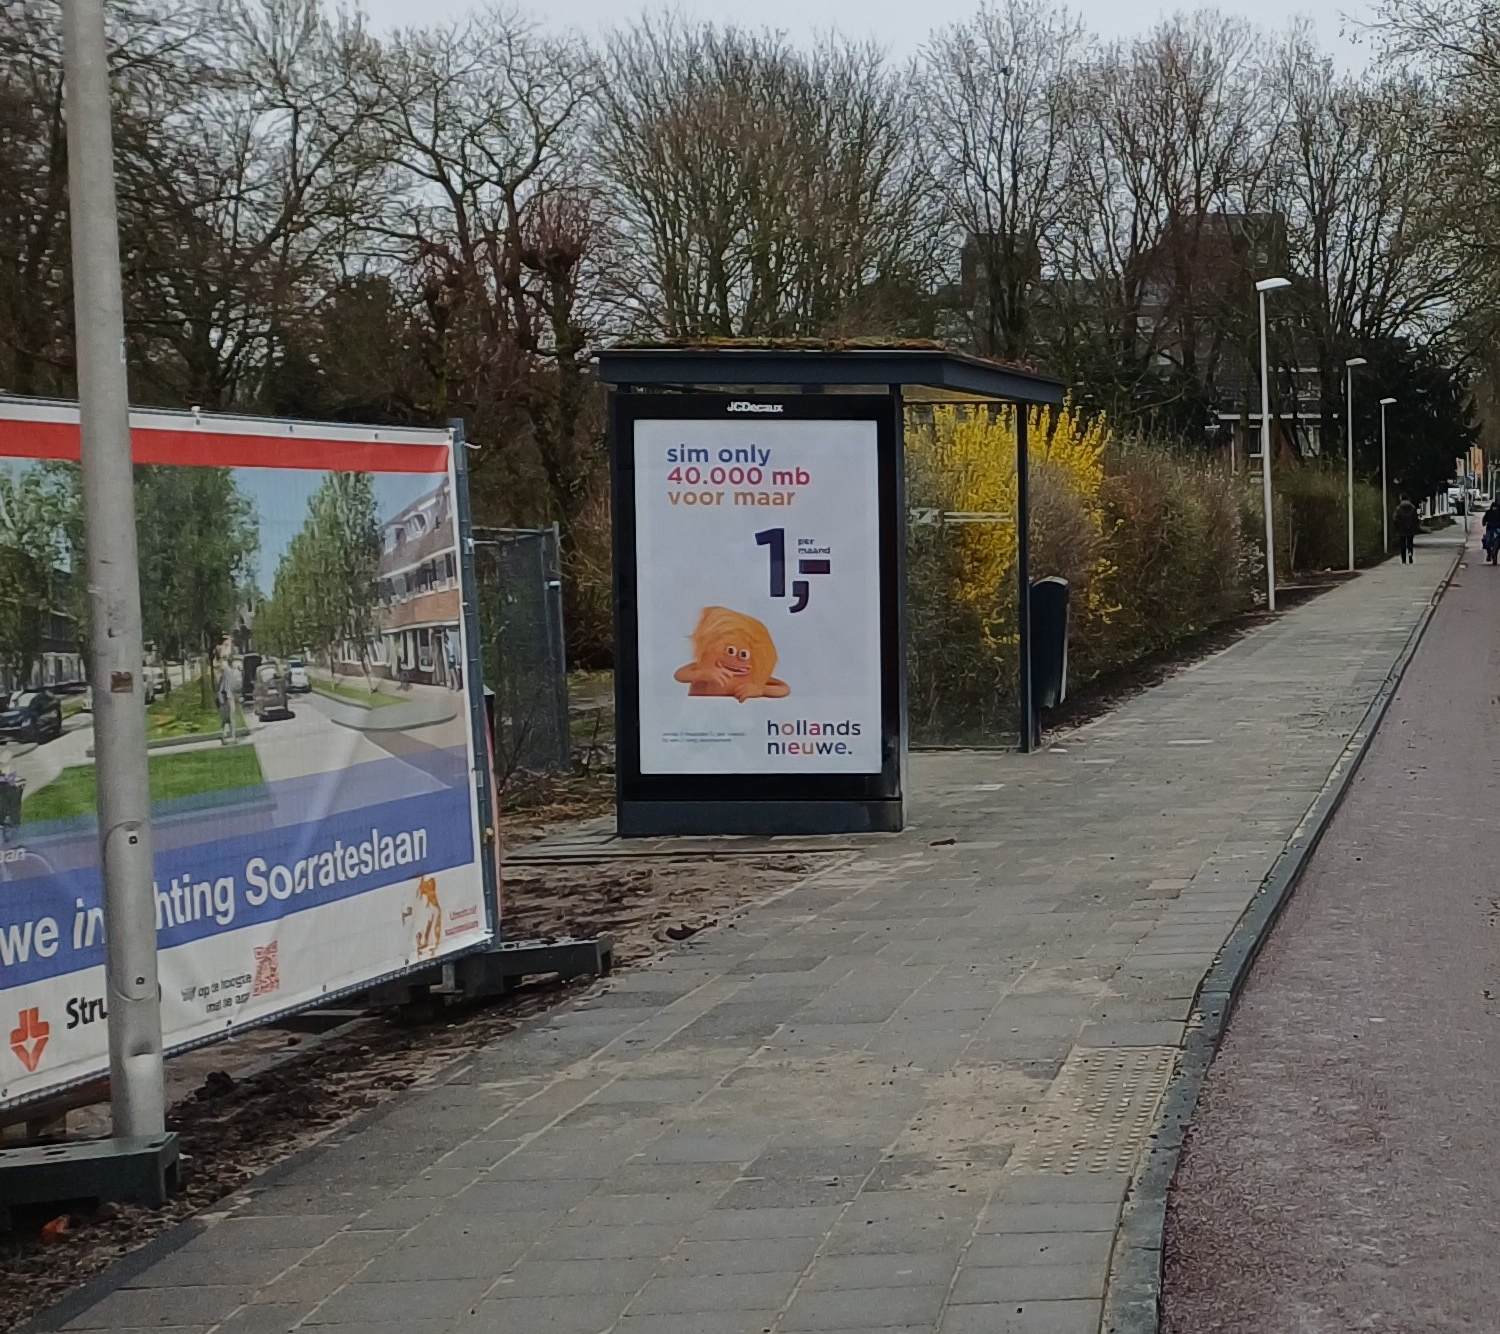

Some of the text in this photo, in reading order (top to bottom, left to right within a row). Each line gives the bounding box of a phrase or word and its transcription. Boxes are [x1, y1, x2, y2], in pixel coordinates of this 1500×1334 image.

[727, 401, 783, 412] JCDecaux
[667, 444, 771, 466] sim only
[667, 467, 810, 485] 40.000 mb
[667, 491, 796, 505] voor maar
[767, 720, 861, 736] hollands
[767, 741, 853, 755] nieuwe.
[245, 828, 427, 906] Socrateslaan
